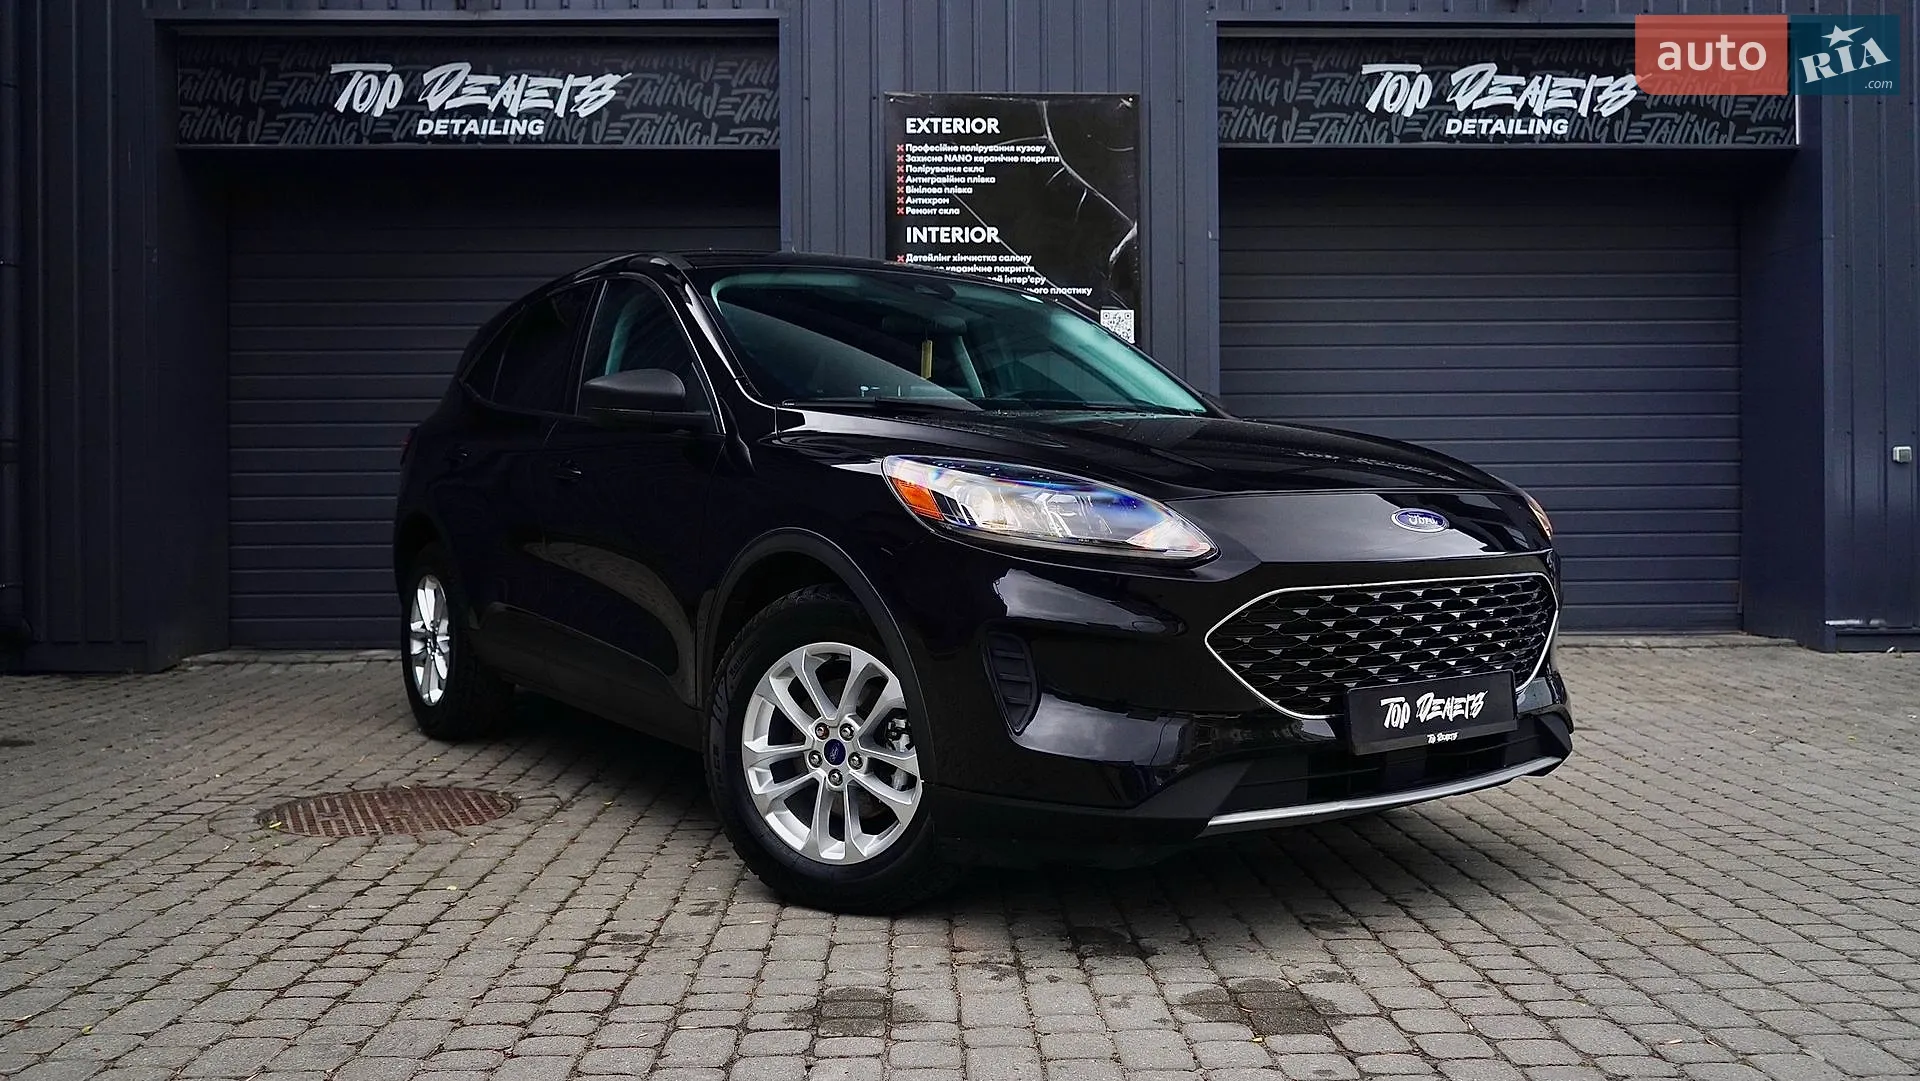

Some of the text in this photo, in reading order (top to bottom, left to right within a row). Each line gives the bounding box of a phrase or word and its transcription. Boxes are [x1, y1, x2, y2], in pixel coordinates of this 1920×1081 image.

[416, 118, 545, 136] DETAILING
[905, 117, 1001, 134] EXTERIOR
[1445, 118, 1570, 135] DETAILING
[905, 143, 1046, 154] Професійне полірування кузову
[905, 154, 1060, 164] Захисне NANO керамічне покриття
[905, 164, 962, 175] Полірування
[905, 175, 996, 185] Антигравійна плівка
[905, 185, 973, 194] Вінілова плівка
[905, 196, 950, 206] Антихром
[905, 207, 938, 215] Ремонт
[906, 226, 1000, 244] INTERIOR
[905, 253, 952, 263] Детейлінг
[998, 255, 1032, 264] салону
[994, 265, 1035, 274] покриття
[1050, 287, 1093, 297] пластику
